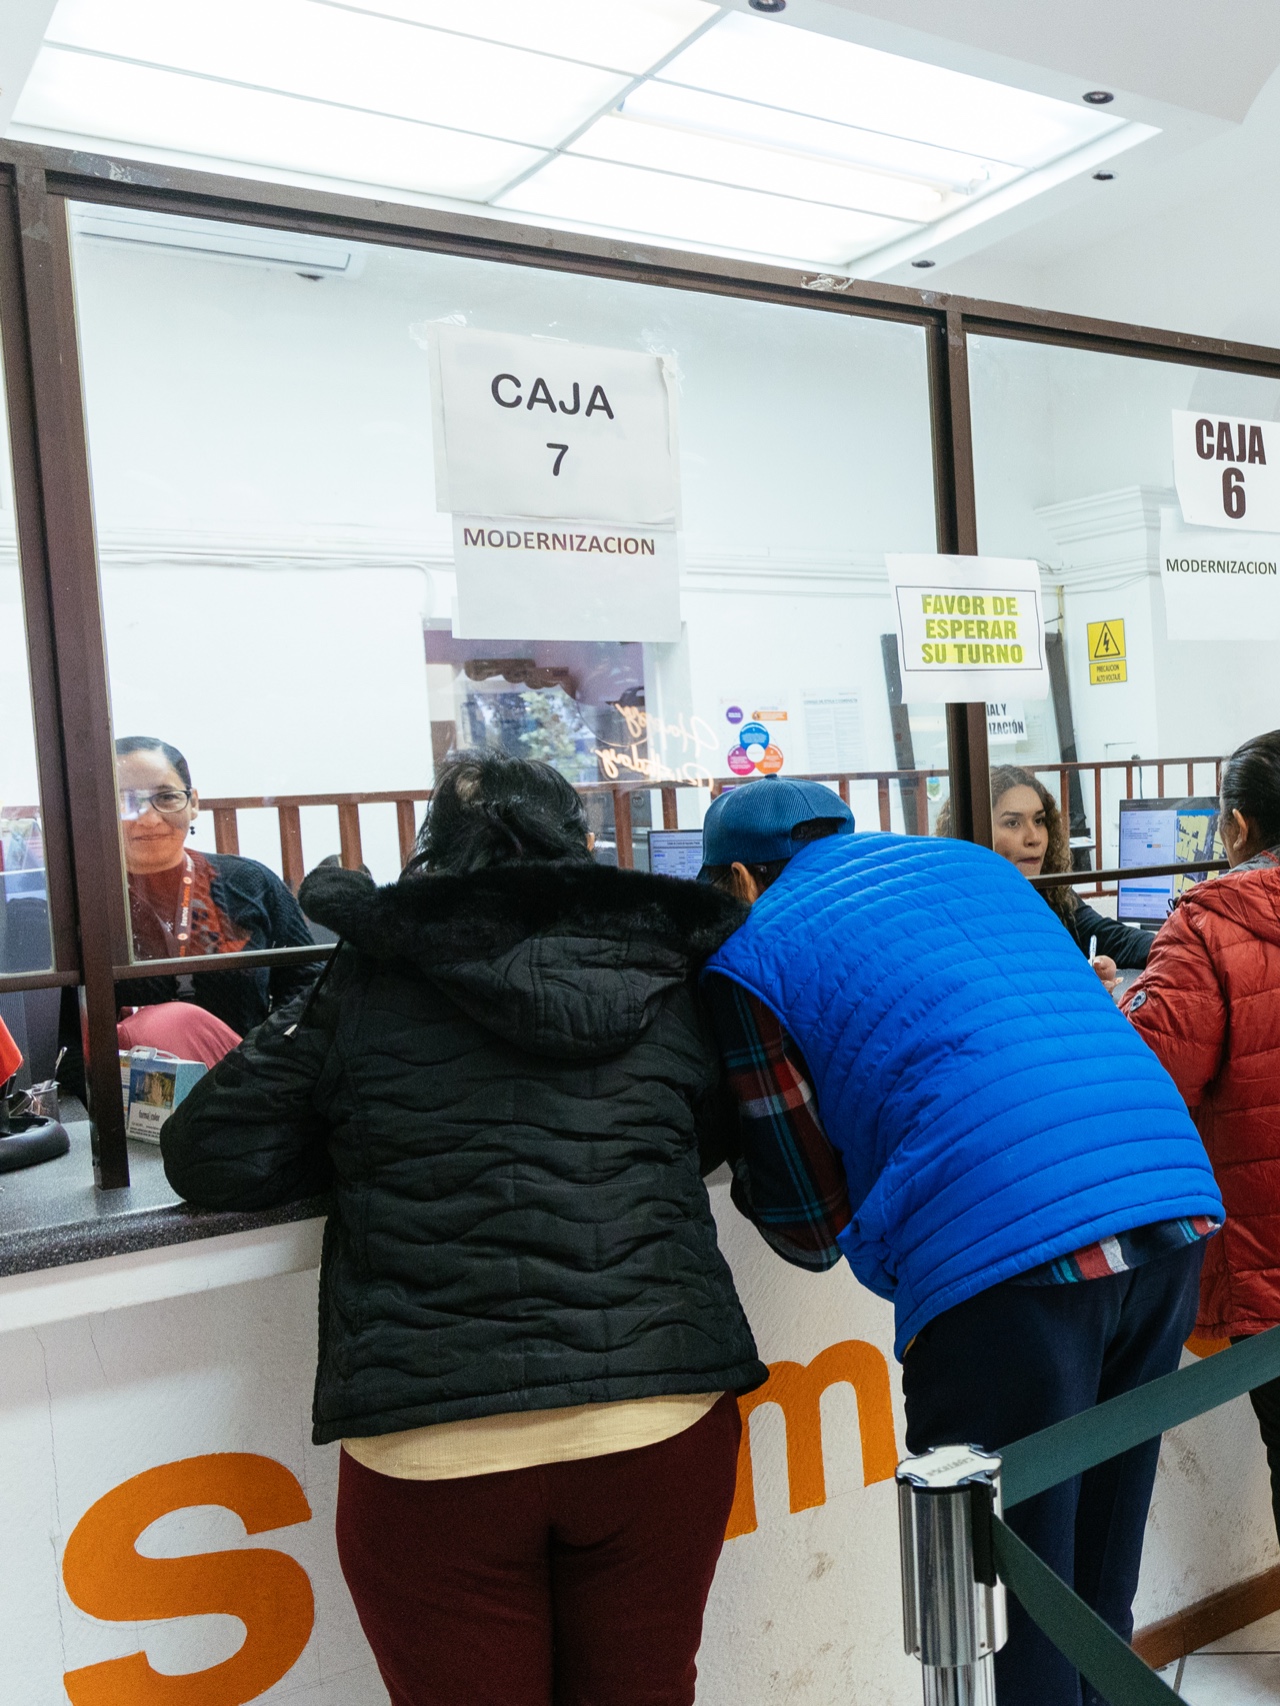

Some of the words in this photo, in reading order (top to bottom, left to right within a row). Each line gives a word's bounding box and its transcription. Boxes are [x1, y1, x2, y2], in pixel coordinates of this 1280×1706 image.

[490, 373, 615, 420] CAJA
[1194, 418, 1267, 465] CAJA
[545, 443, 570, 477] 7
[1221, 467, 1247, 520] 6
[462, 527, 656, 556] MODERNIZACION
[1165, 558, 1278, 576] MODERNIZACION
[921, 594, 985, 616] FAVOR
[992, 597, 1018, 617] DE
[925, 619, 1017, 640] ESPERAR
[921, 643, 948, 665] SU
[953, 643, 1023, 664] TURNO
[986, 703, 1000, 716] IAL
[1001, 703, 1006, 716] Y
[988, 719, 1024, 735] IZACIÓN
